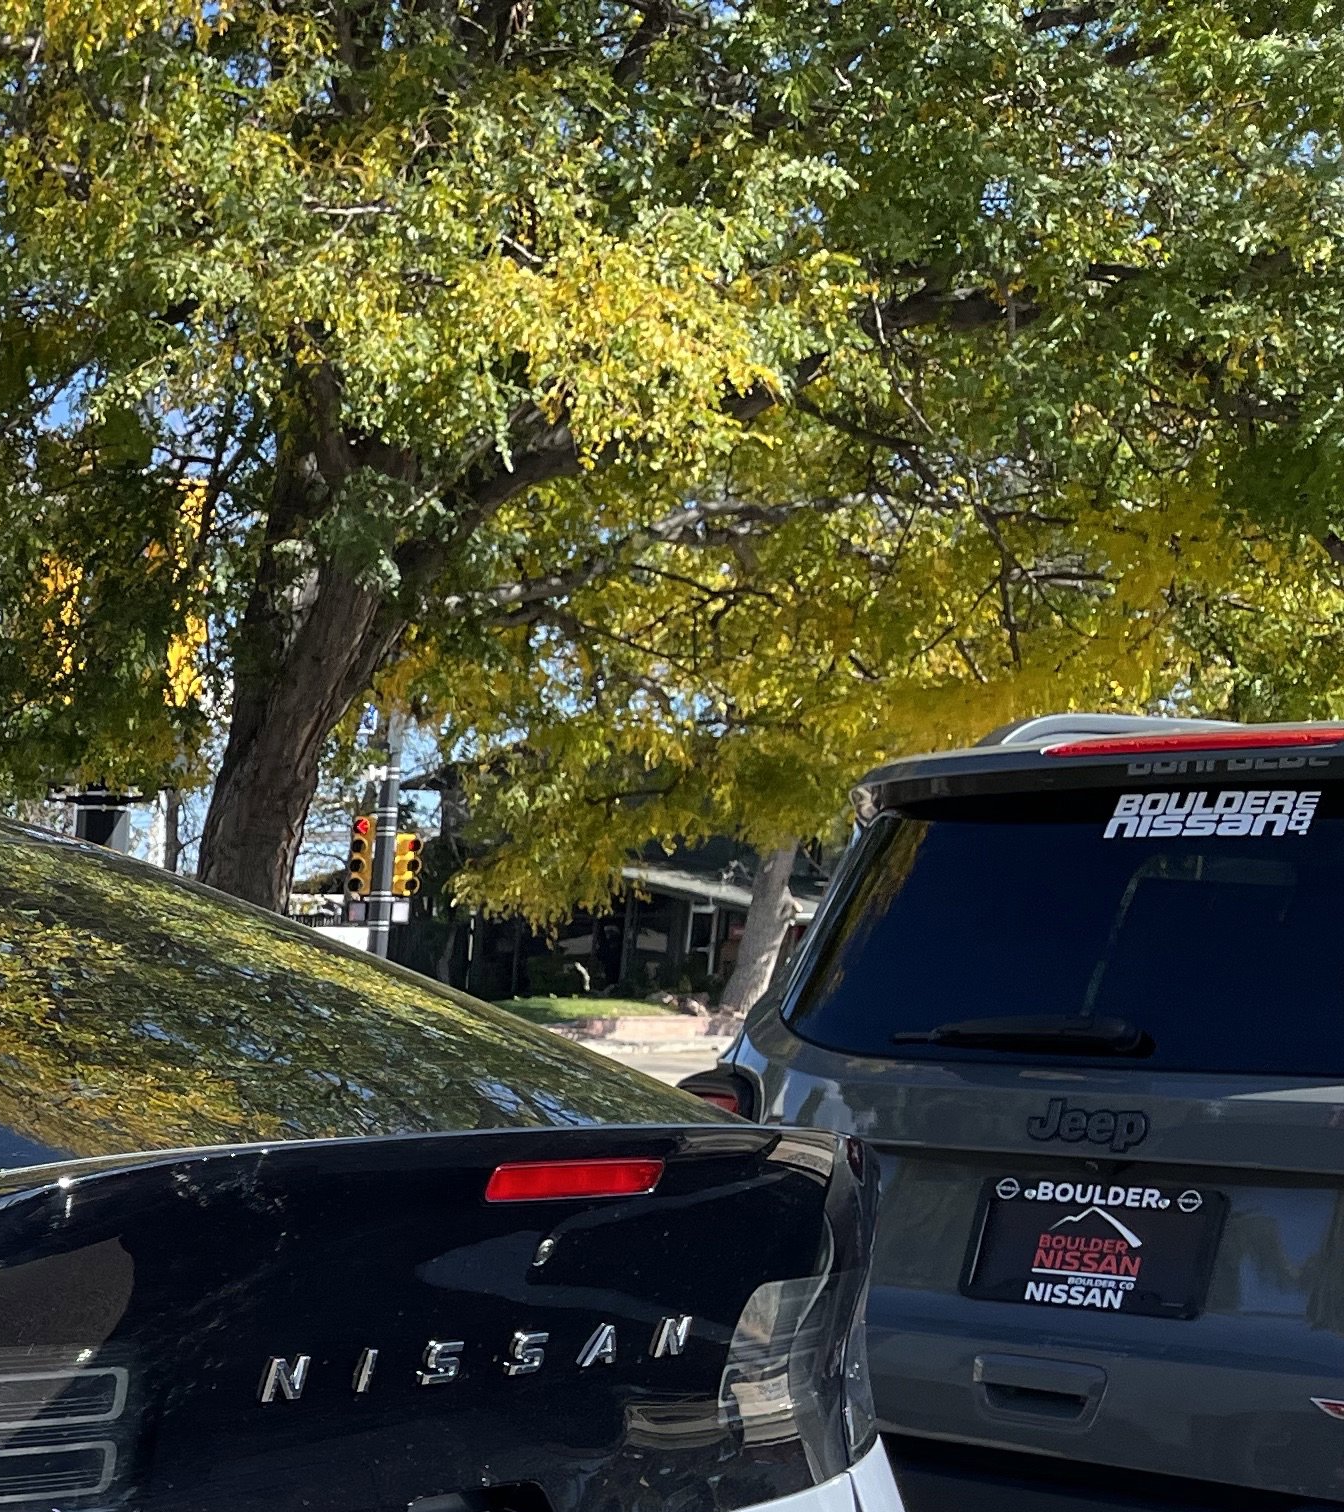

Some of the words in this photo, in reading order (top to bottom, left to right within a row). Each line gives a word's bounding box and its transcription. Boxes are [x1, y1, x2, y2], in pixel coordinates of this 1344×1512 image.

[1112, 790, 1298, 817] BOULDER
[1026, 1098, 1151, 1154] Jeep
[1036, 1181, 1161, 1209] BOULDER
[1038, 1234, 1129, 1255] BOULDER
[1032, 1248, 1143, 1277] NISSAN
[1024, 1281, 1124, 1310] NISSAN
[257, 1314, 693, 1403] NISSAN
